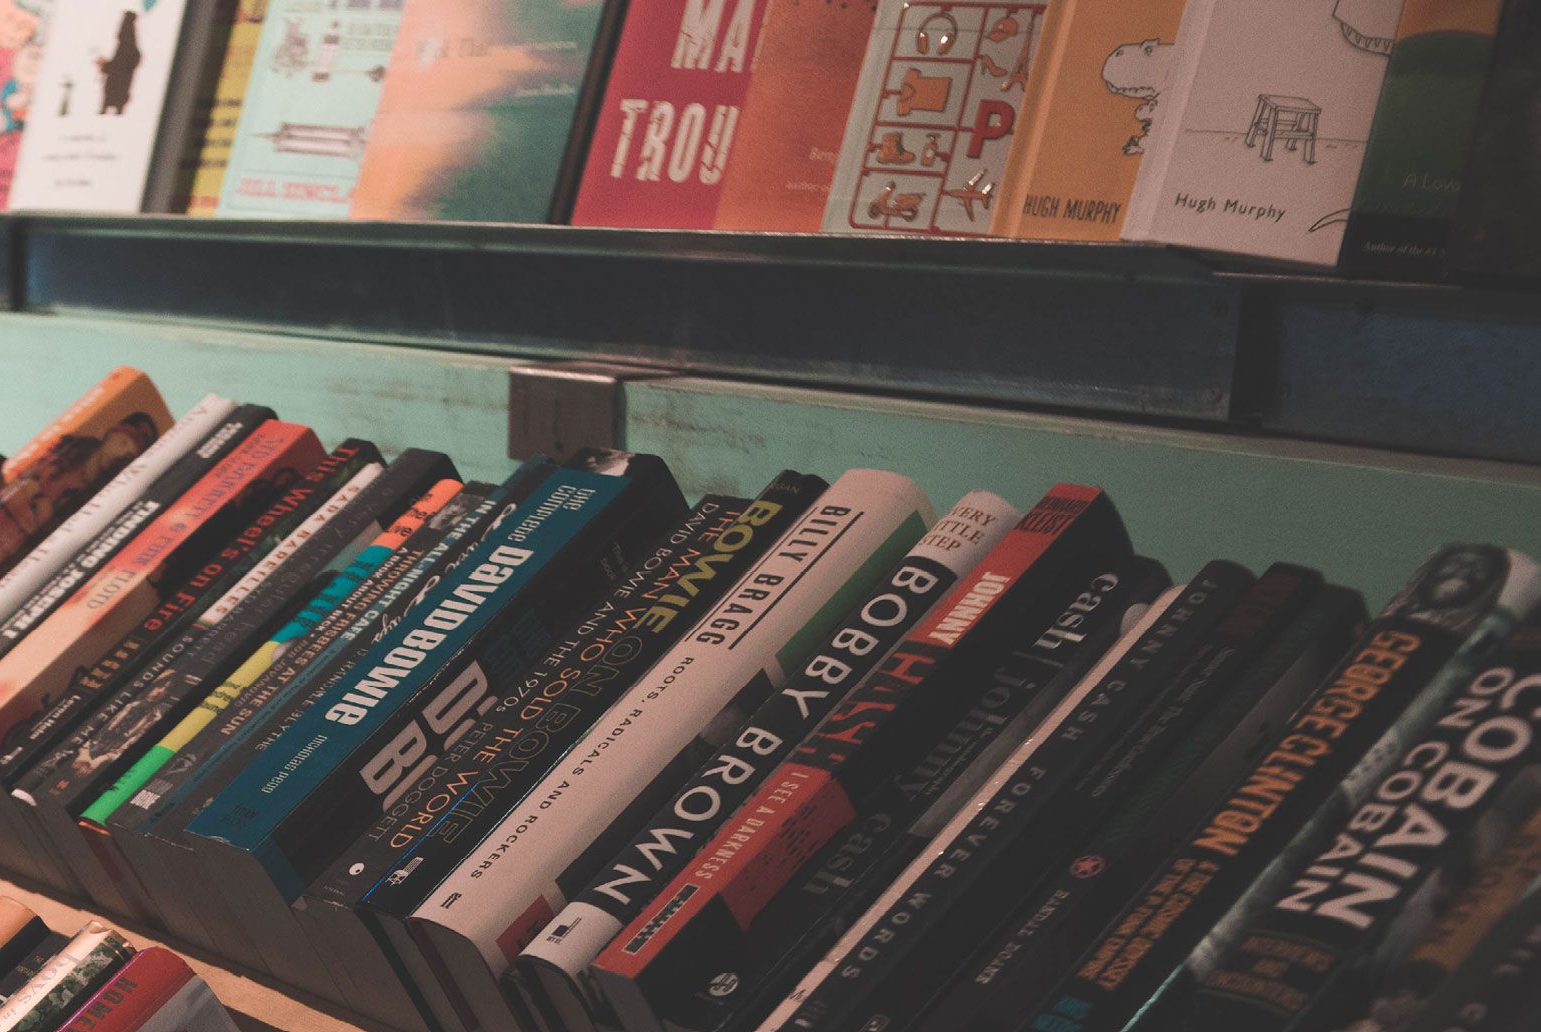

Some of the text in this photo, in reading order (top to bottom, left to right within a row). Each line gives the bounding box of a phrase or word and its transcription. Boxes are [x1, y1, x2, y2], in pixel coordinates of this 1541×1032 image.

[967, 99, 1017, 159] P
[1023, 193, 1121, 225] HUGH MURPHY
[1174, 192, 1286, 223] Hugh Murphy
[141, 442, 359, 632] This Wheel's on Fire
[446, 515, 479, 541] THE
[474, 499, 496, 514] IN
[691, 499, 851, 650] BILLY BRAGG
[925, 568, 1011, 647] JOHNNY
[1028, 572, 1130, 658] cash
[218, 547, 425, 735] THROWING FRISBEES AT THE SUN
[364, 497, 720, 843] DAVID BOWIE AND THE 1970s PETER DOGGETT
[423, 490, 788, 848] BOWIE ON BOWIE
[1125, 577, 1219, 670] JOHNNY
[384, 504, 744, 851] THE MAN WHO SOLD THE WORLD
[1056, 676, 1128, 744] CASH
[467, 653, 695, 881] ROOTS, RADICALS AND ROCKERS
[591, 565, 939, 902] BOBBY BROWN
[765, 779, 798, 806] SEE
[928, 766, 1050, 882] FOREVER
[1188, 734, 1332, 857] CLINTON
[1269, 665, 1519, 915] ON COBAIN
[692, 816, 763, 881] DARKNESS
[835, 888, 934, 982] WORDS
